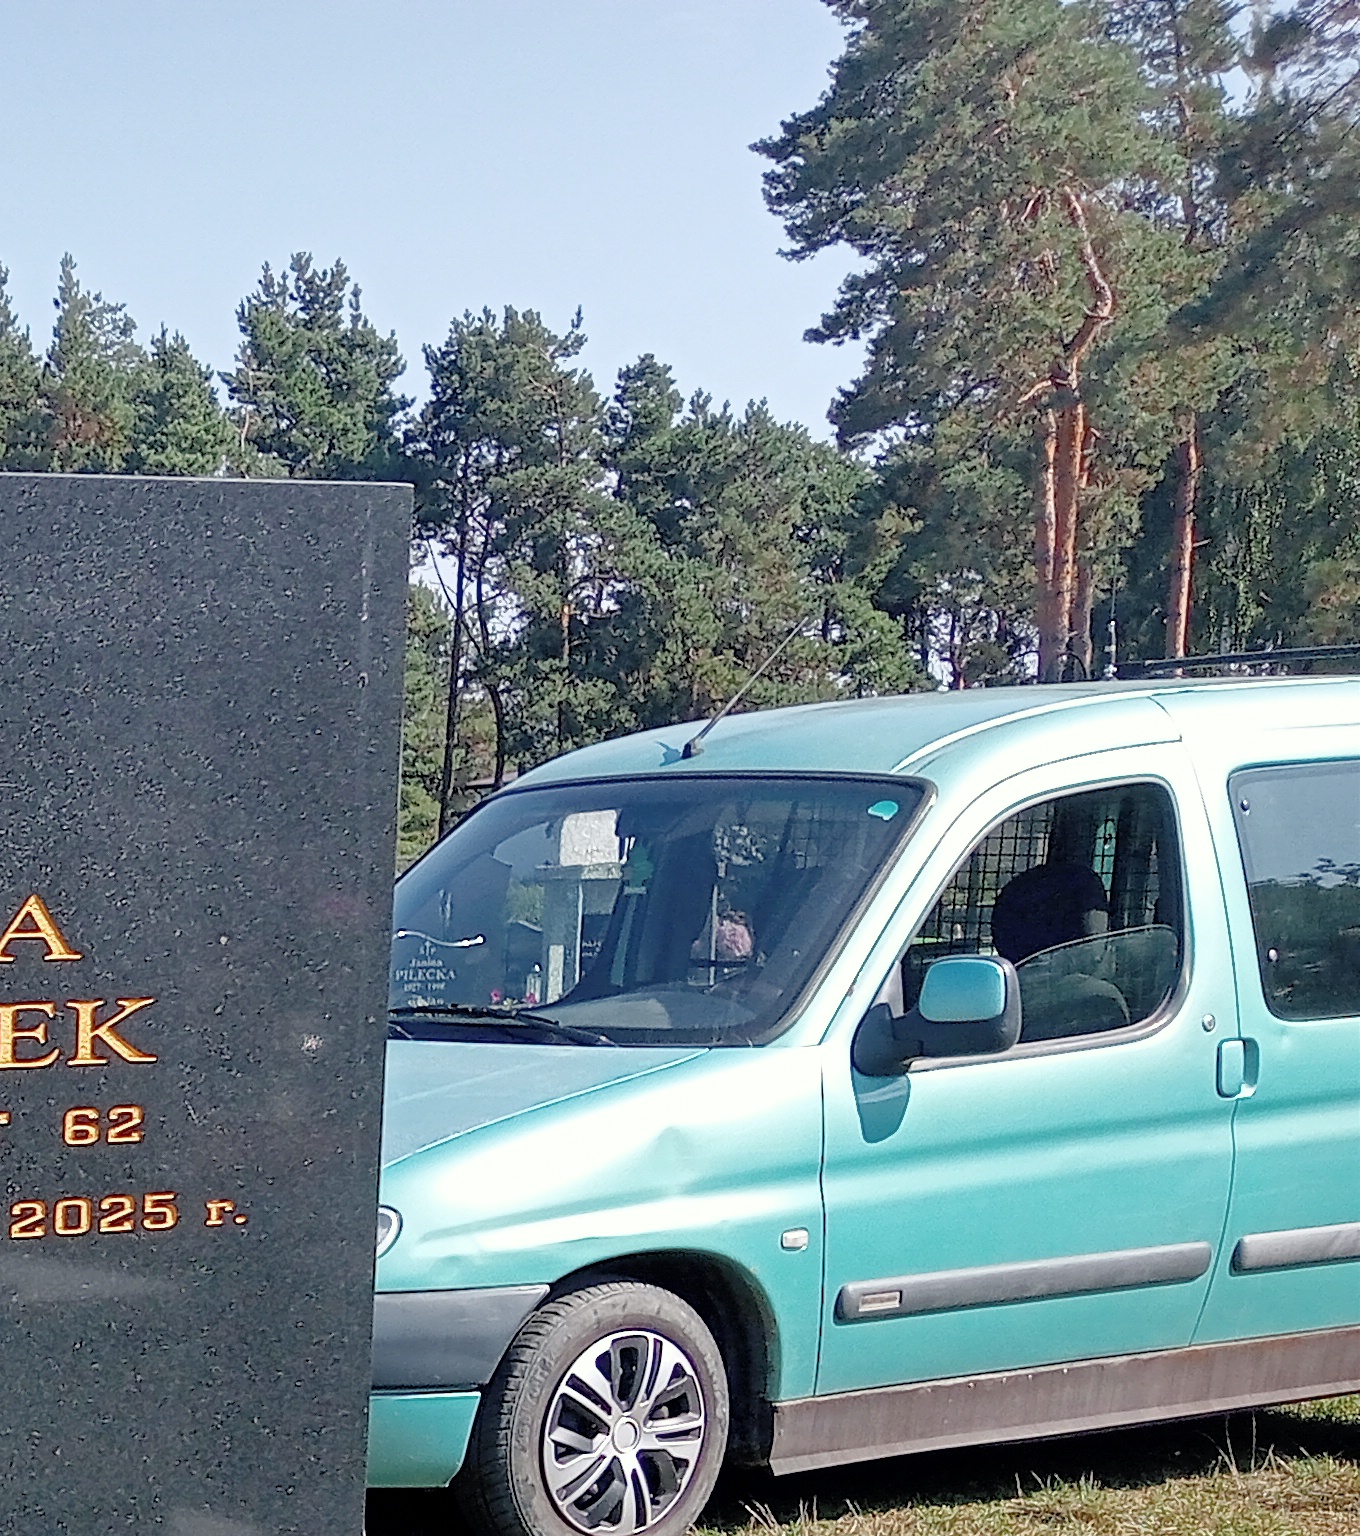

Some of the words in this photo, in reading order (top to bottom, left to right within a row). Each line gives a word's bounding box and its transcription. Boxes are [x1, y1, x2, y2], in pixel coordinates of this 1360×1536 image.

[62, 1104, 145, 1145] 62
[9, 1190, 180, 1240] 2025
[206, 1199, 249, 1228] r.
